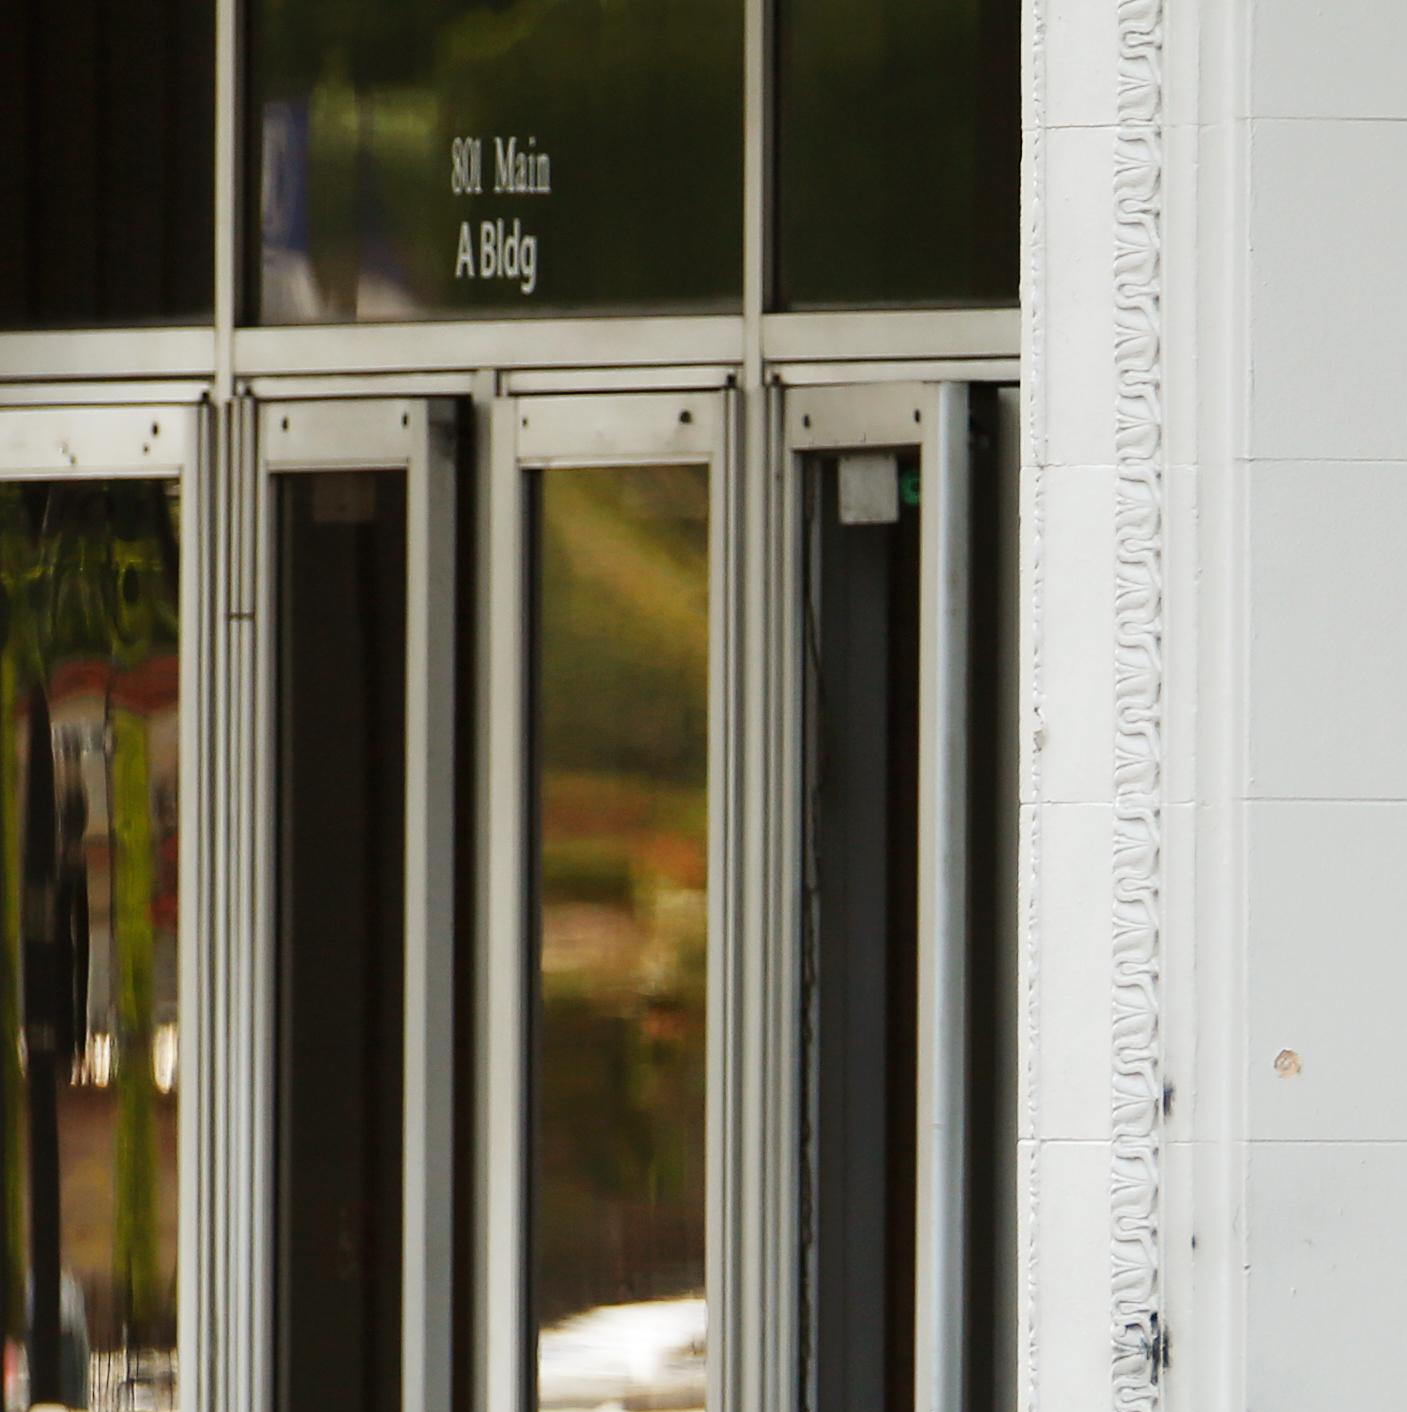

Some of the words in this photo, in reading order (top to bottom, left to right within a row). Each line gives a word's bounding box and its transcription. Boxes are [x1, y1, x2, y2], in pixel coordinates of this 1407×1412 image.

[451, 136, 482, 194] 801
[494, 136, 551, 193] Main
[455, 220, 475, 278] A
[480, 218, 537, 295] Bldg
